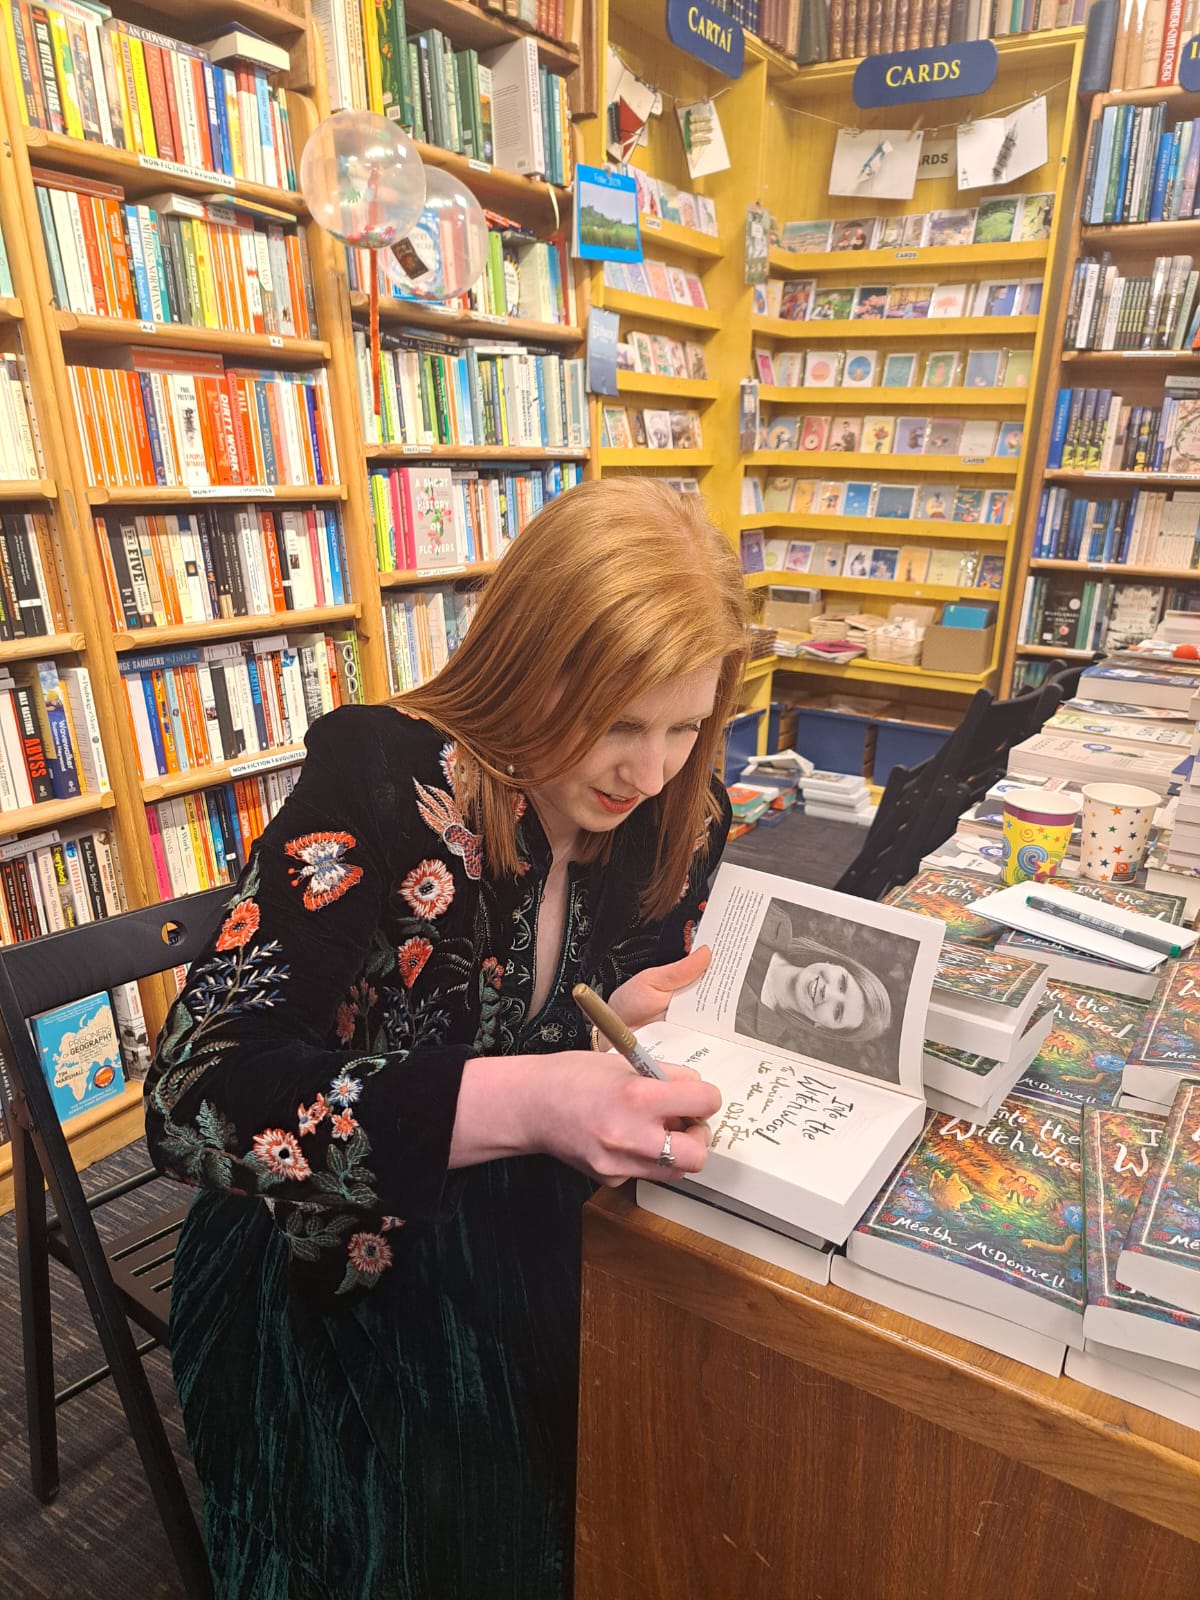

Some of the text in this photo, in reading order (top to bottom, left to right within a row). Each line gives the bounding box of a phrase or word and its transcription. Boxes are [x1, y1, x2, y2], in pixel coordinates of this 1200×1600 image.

[142, 31, 178, 50] ODYSSEY
[688, 6, 732, 53] CARTAÍ
[38, 42, 56, 80] HITLER
[885, 59, 962, 88] CARDS
[44, 80, 61, 112] YEARS
[220, 394, 240, 473] DIRTY WORK
[415, 480, 421, 488] A
[127, 549, 145, 583] FIVE
[265, 518, 280, 588] SEDARIS
[118, 656, 165, 671] RGE SAUNDERS
[342, 644, 358, 694] GOD
[18, 691, 35, 736] MAX HASTINGS
[24, 738, 47, 778] ABYSS
[58, 720, 74, 769] Wavewalker
[181, 831, 190, 851] Work
[53, 846, 68, 886] Everybody
[948, 878, 977, 889] Into
[1074, 884, 1144, 905] Into the
[1075, 995, 1110, 1013] the
[68, 1025, 113, 1049] PRISONERS
[70, 1032, 113, 1056] GEOGRAPHY
[56, 1069, 85, 1085] MARSHALL
[57, 1070, 68, 1078] TIM
[1017, 1077, 1097, 1104] McDonnell
[802, 1096, 854, 1141] Into the
[1040, 1120, 1081, 1145] the
[893, 1216, 1067, 1290] Méabh McDonnell
